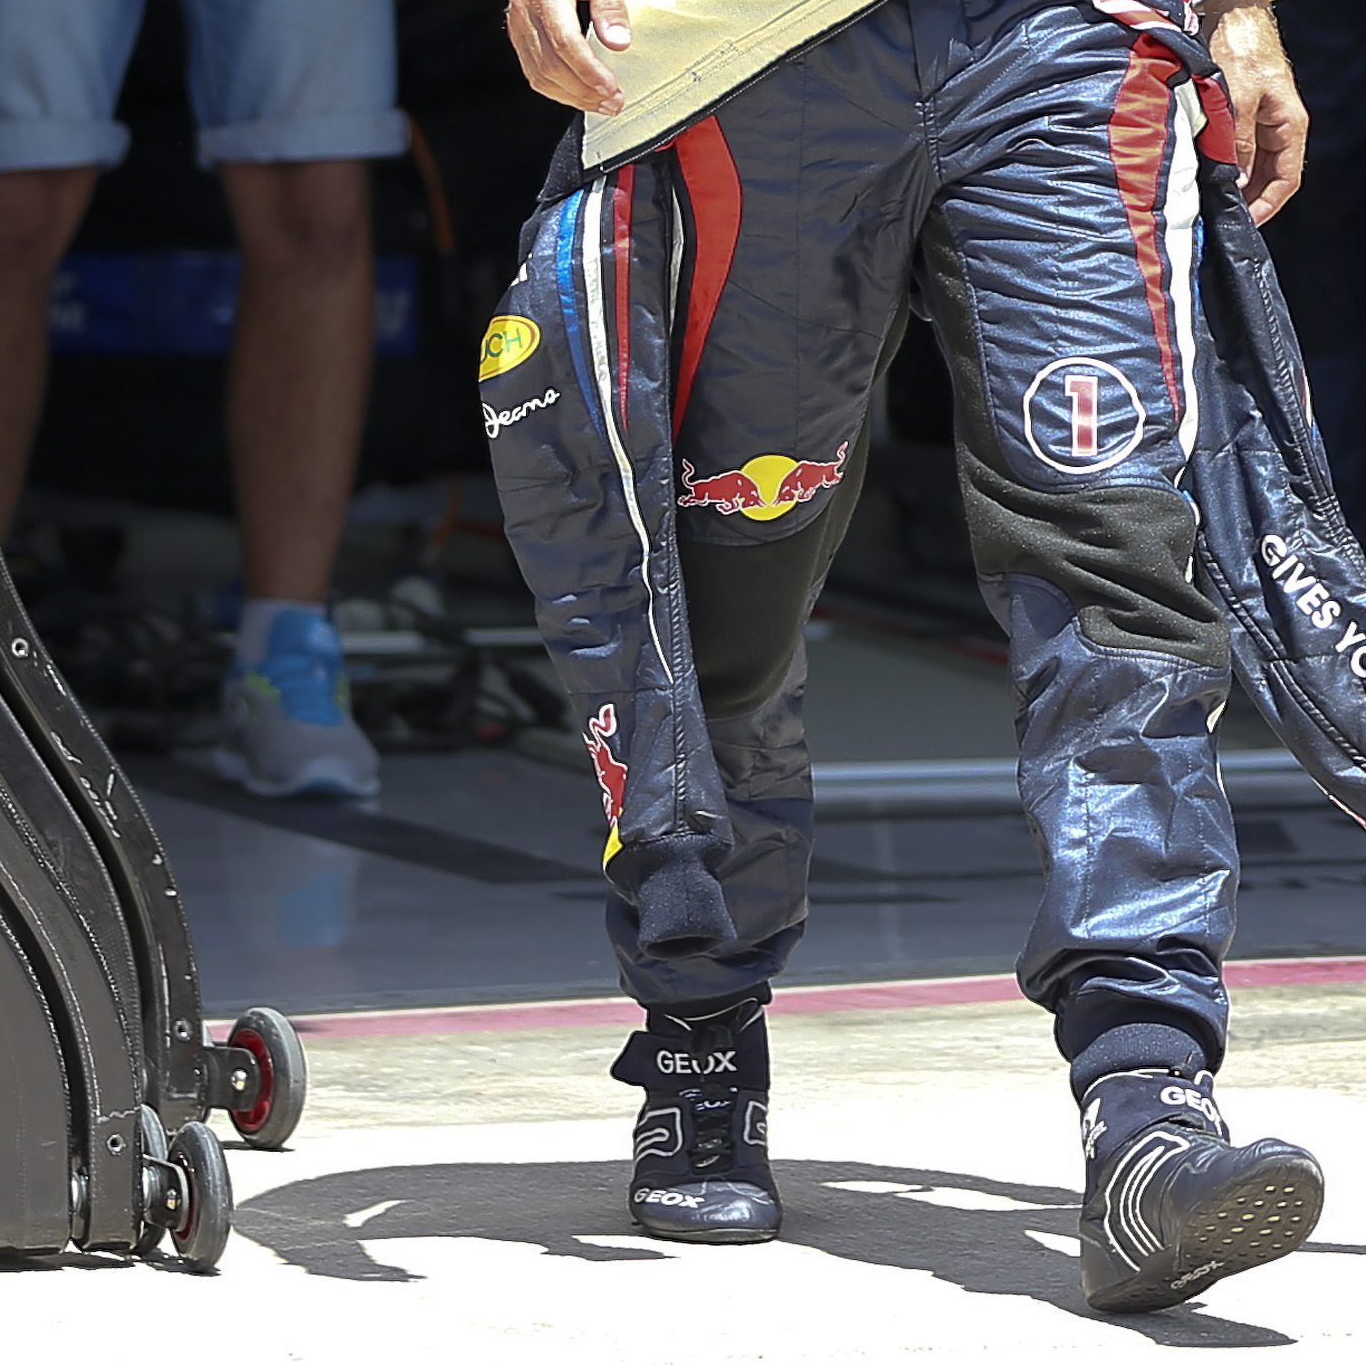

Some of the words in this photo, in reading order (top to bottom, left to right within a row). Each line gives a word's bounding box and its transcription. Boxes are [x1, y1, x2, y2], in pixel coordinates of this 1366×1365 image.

[481, 388, 561, 440] Jeans
[1064, 374, 1099, 457] 1
[1260, 533, 1342, 630] GIVES
[656, 1049, 738, 1075] GEOX
[634, 1187, 706, 1209] GEOX
